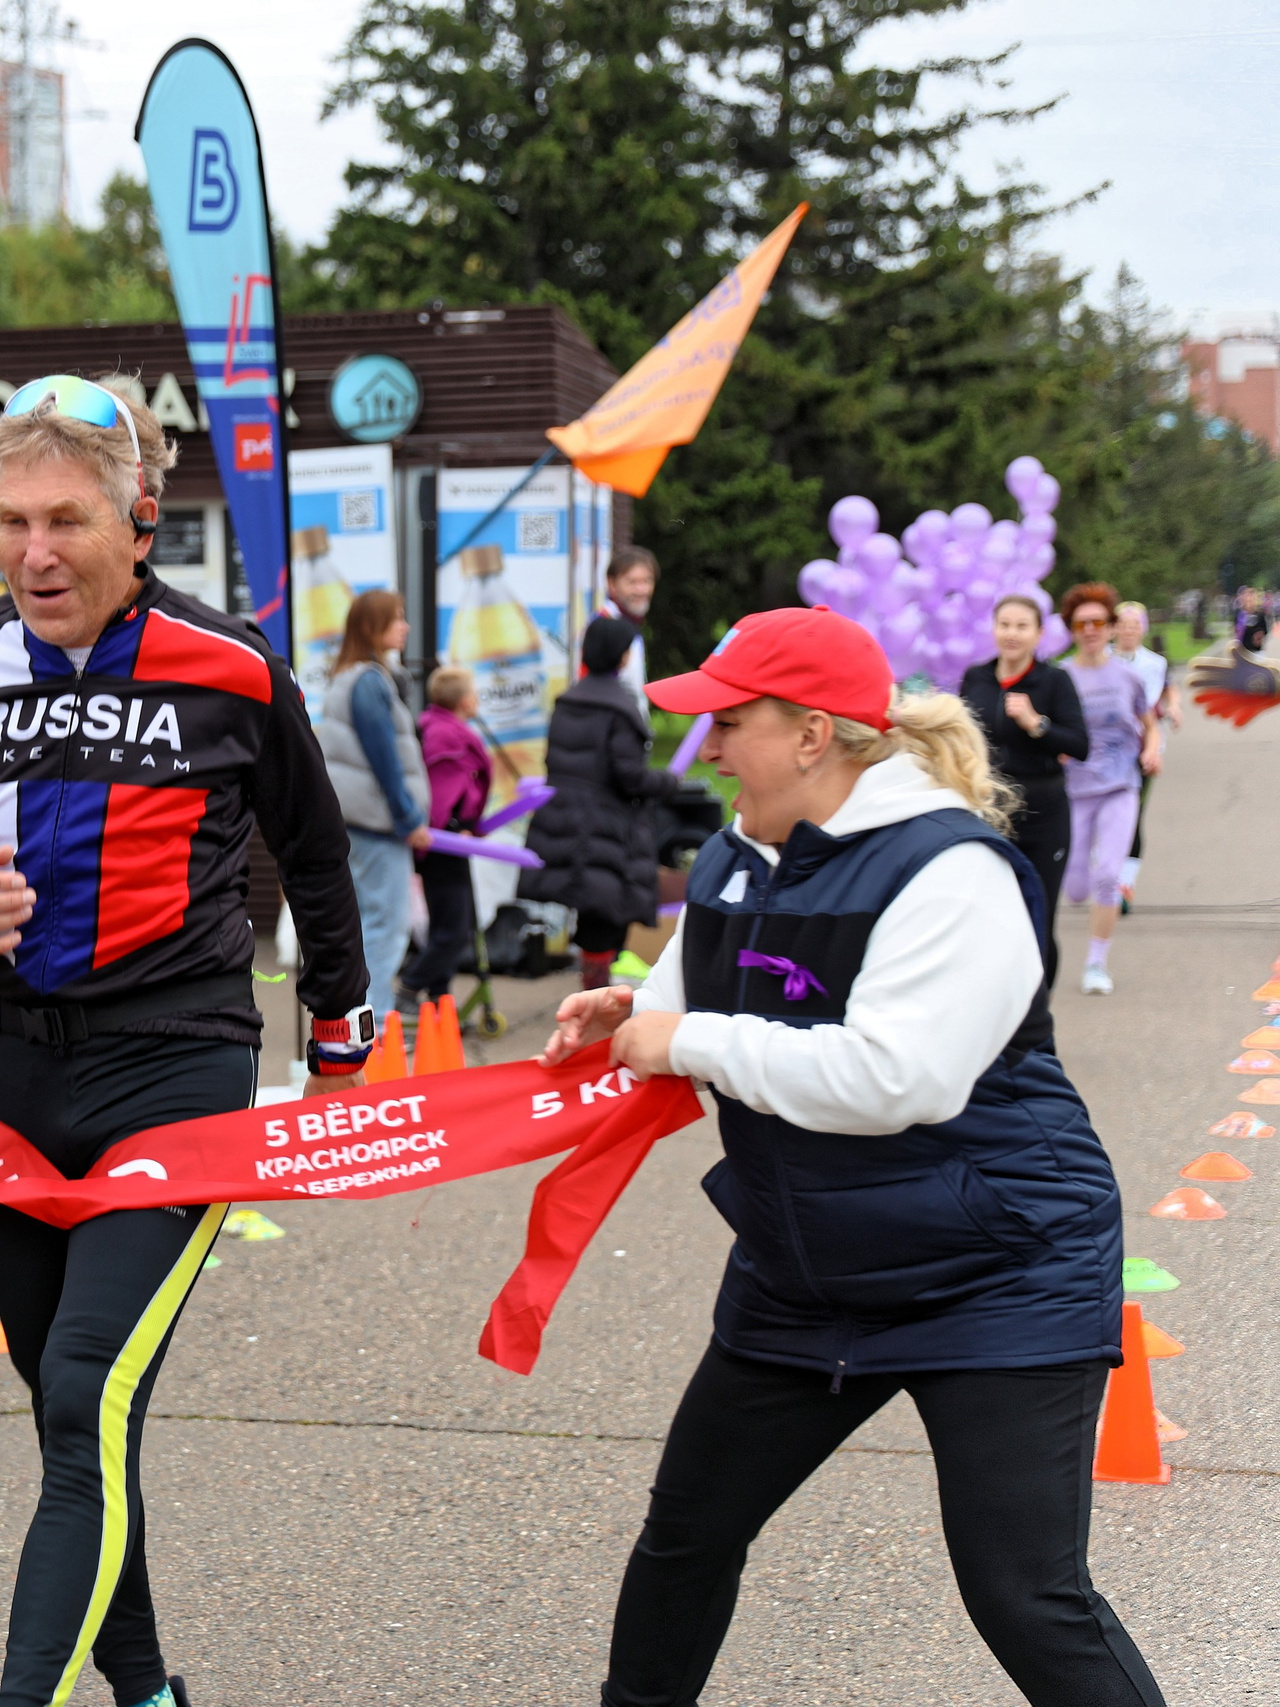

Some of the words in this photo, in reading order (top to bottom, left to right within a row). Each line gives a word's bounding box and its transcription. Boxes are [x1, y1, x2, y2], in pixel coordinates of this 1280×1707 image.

[79, 745, 191, 773] TEAM
[264, 1118, 291, 1148] 5
[296, 1094, 427, 1143] ВЁРСТ
[530, 1090, 565, 1120] 5
[254, 1128, 450, 1181] КРАСНОЯРСК
[281, 1155, 442, 1196] АБЕРЕЖНАЯ
